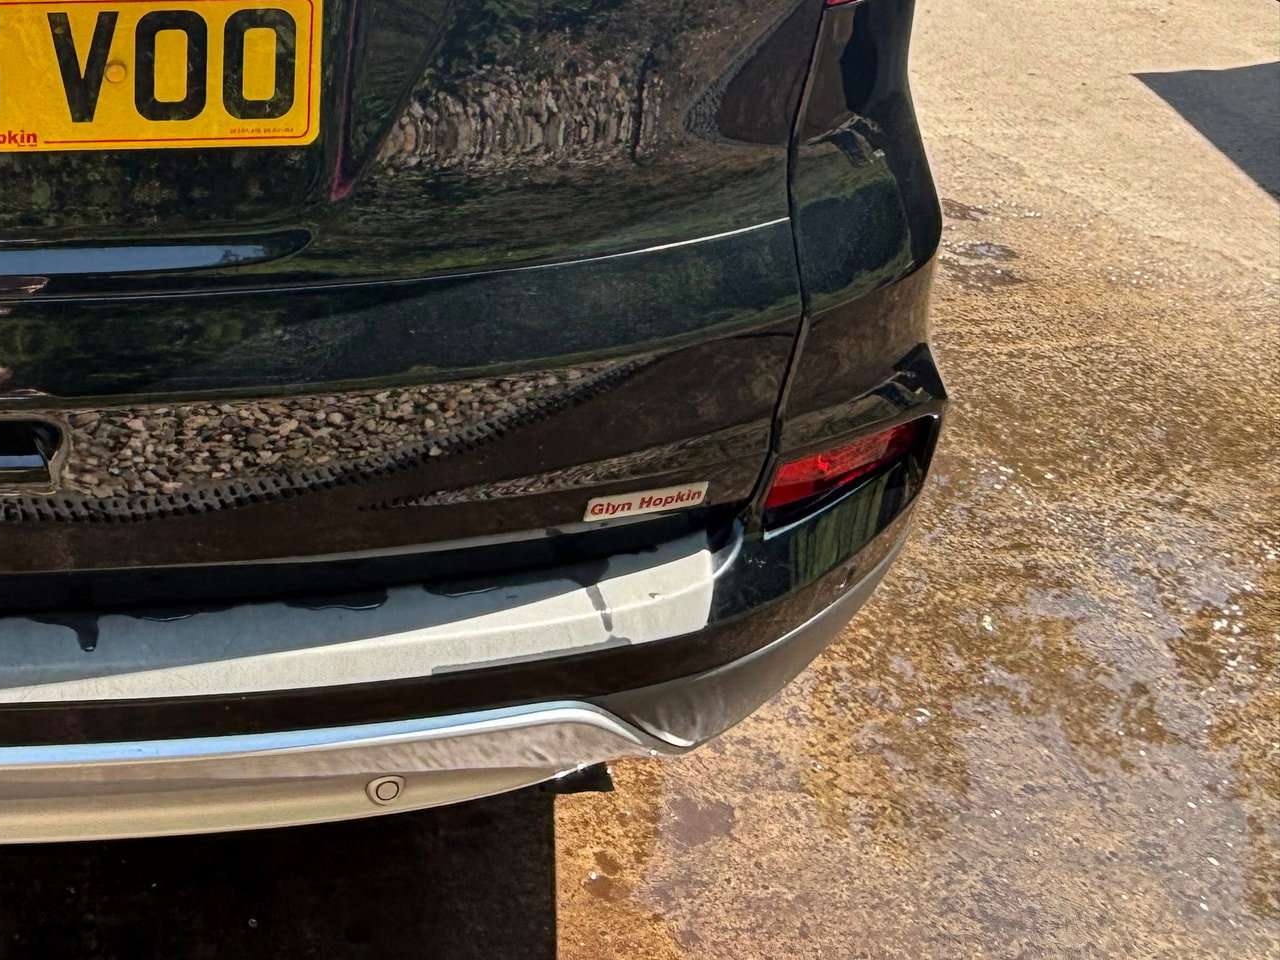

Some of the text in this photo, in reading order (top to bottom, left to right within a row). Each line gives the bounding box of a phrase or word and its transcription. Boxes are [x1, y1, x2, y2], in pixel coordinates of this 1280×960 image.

[47, 7, 297, 124] VOO
[590, 488, 701, 515] Glyn Hopkin
